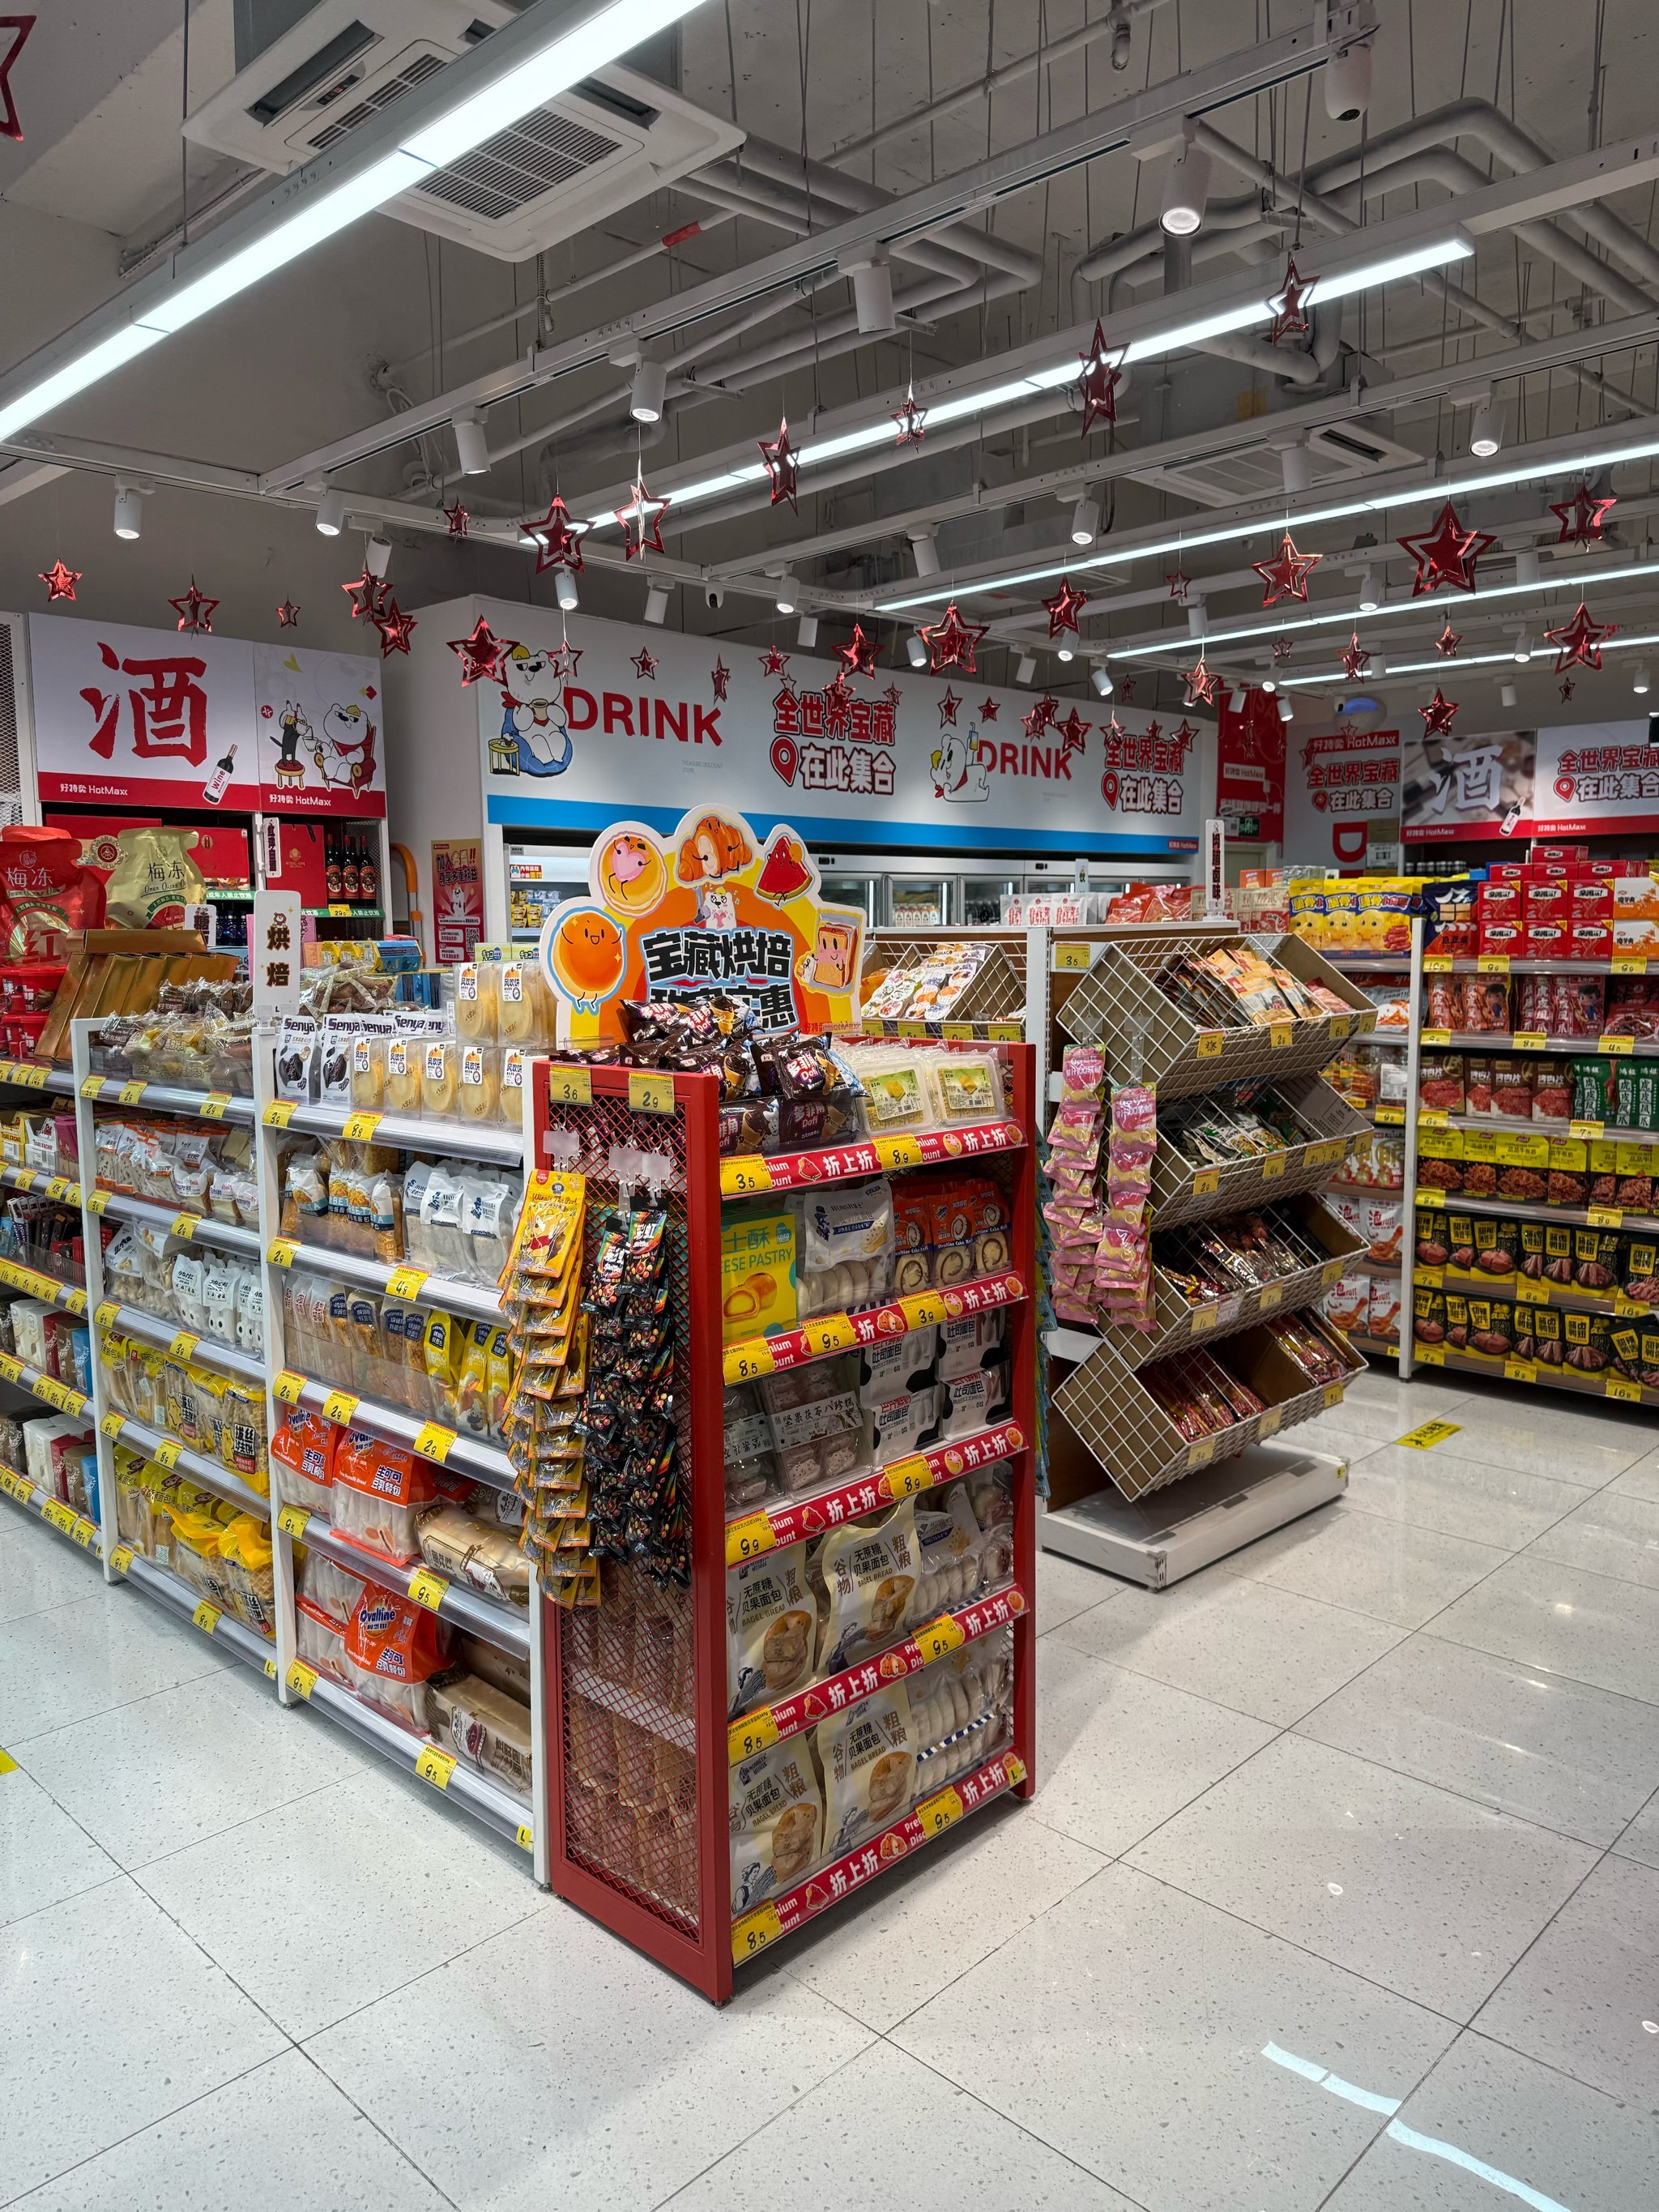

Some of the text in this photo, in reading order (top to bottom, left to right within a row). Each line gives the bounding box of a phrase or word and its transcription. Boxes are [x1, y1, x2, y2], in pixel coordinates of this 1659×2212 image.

[79, 642, 207, 767] 酒
[567, 686, 723, 746] DRINK
[774, 690, 895, 745] 全世界宝藏
[799, 746, 895, 794] 在此集合
[977, 741, 1073, 781] DRINK
[1307, 758, 1400, 789] 全世界宝藏
[1558, 745, 1659, 775] 全世界宝藏
[1120, 775, 1183, 814] 在此集合
[1430, 745, 1503, 815] 酒
[1577, 773, 1659, 802] 在此集合
[1329, 788, 1393, 812] 在此集合
[6, 868, 53, 887] 梅冻
[147, 862, 185, 882] 梅冻
[22, 929, 62, 964] 红
[267, 926, 290, 987] 烘焙
[643, 931, 791, 982] 宝藏烘焙
[284, 1018, 315, 1035] Senya
[328, 1017, 360, 1035] Senya
[965, 1129, 1007, 1151] 折上折
[824, 1148, 873, 1179] 折上折
[749, 1248, 792, 1268] PASTRY
[963, 1283, 1007, 1310] 折上折
[948, 1321, 975, 1339] 吐司面包
[872, 1343, 902, 1364] 吐司面包
[953, 1381, 985, 1398] 吐司面包
[880, 1405, 909, 1426] 吐司面包
[964, 1433, 1008, 1465] 折上折
[371, 1477, 402, 1497] 豆乳餐包
[377, 1466, 403, 1483] 生可可
[826, 1486, 876, 1523] 折上折
[854, 1555, 889, 1577] 贝果面包
[855, 1543, 882, 1562] 无蔗糖
[892, 1534, 911, 1570] 粗粮
[744, 1577, 774, 1599] 无蔗糖
[785, 1567, 804, 1605] 粗粮
[834, 1558, 851, 1597] 谷物
[742, 1590, 783, 1616] 贝果面包
[965, 1599, 1009, 1633] 折上折
[827, 1666, 878, 1710] 折上折
[850, 1722, 873, 1745] 无蔗糖
[883, 1710, 908, 1747] 粗粮
[848, 1733, 881, 1760] 贝果面包
[851, 1745, 886, 1771] BAGEL BREAD
[833, 1743, 844, 1783] 谷物
[746, 1776, 773, 1803] 无蔗糖
[782, 1761, 808, 1799] 粗粮
[963, 1762, 1006, 1806] 折上折
[745, 1787, 782, 1817] 贝果面包
[752, 1800, 787, 1827] BAGEL BREAD
[830, 1851, 879, 1897] 折上折
